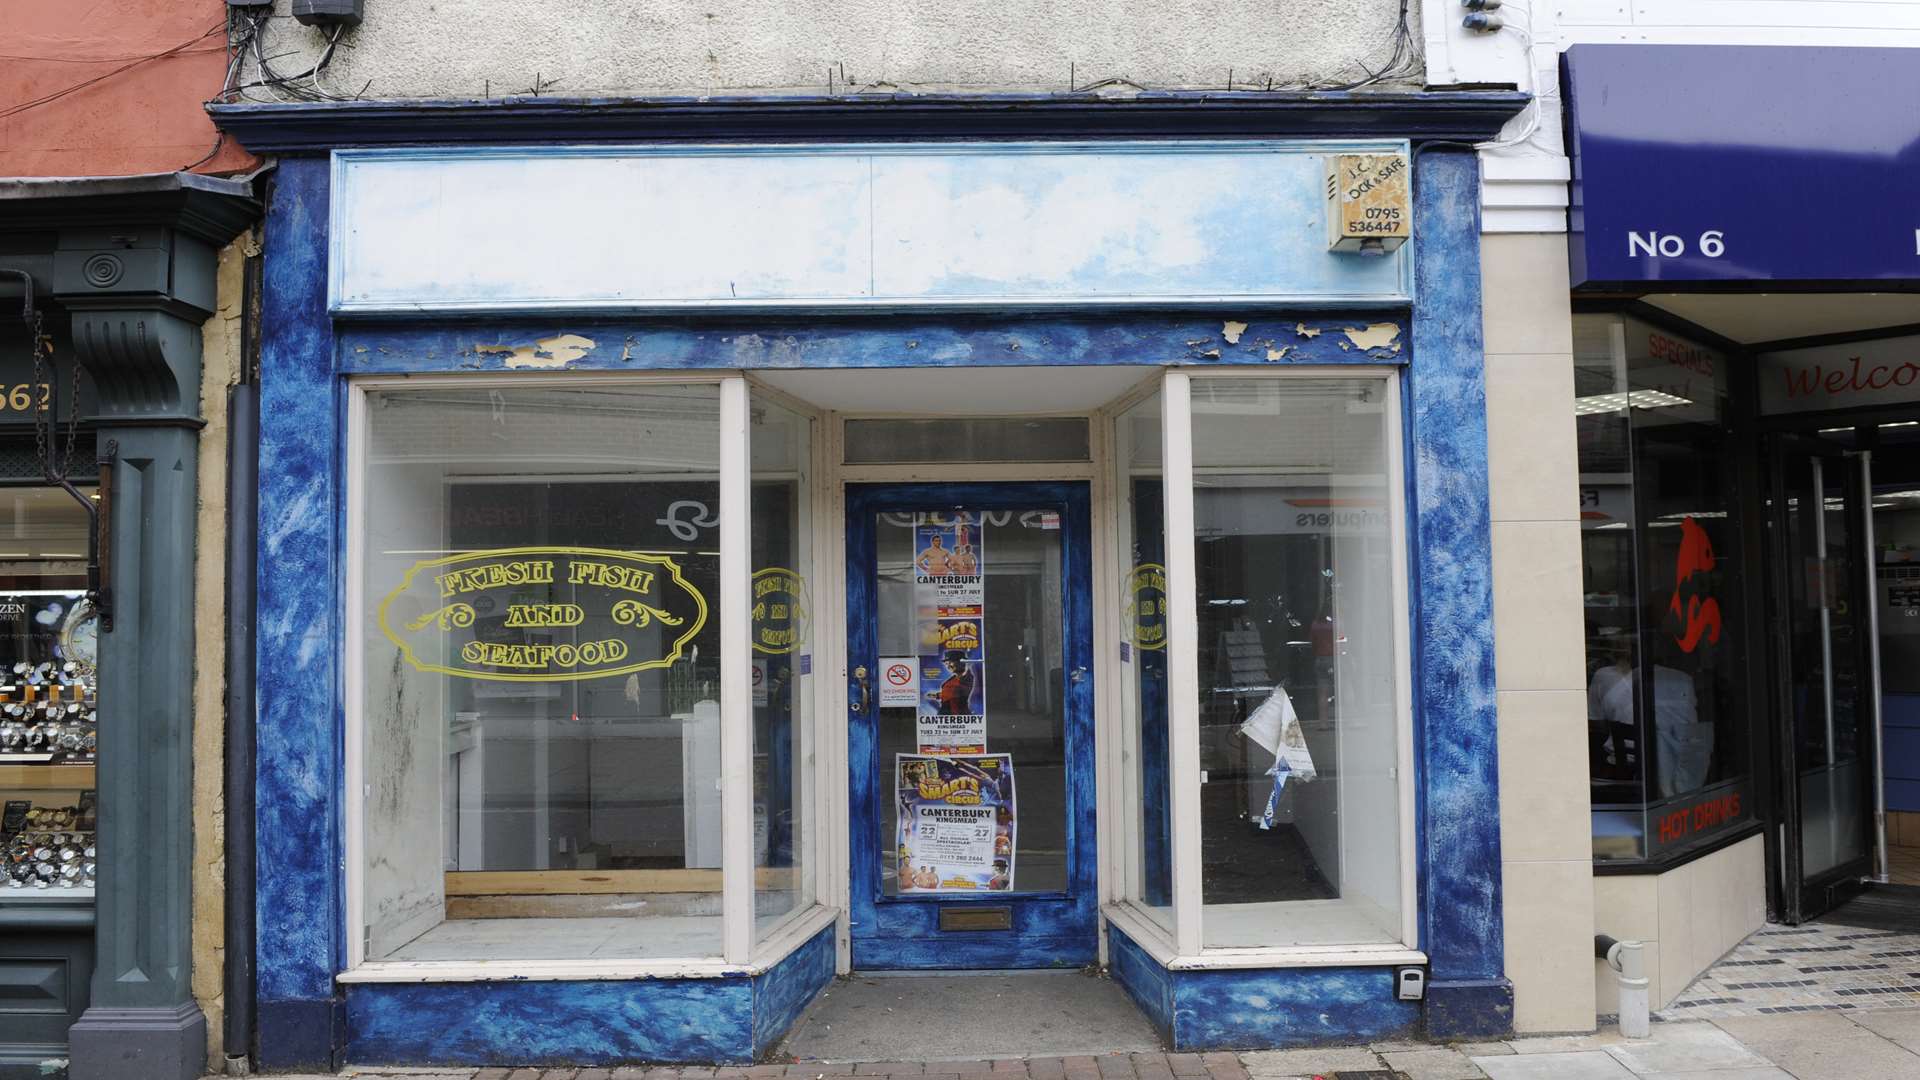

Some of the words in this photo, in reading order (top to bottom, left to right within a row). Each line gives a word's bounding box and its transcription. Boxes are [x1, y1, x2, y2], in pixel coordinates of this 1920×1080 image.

[1349, 179, 1375, 199] OCK
[1378, 158, 1406, 180] SAFE
[1365, 207, 1400, 219] 0795
[1349, 221, 1400, 233] 536447
[1628, 231, 1685, 257] No
[1699, 230, 1725, 257] 6
[1649, 332, 1713, 378] SPECIALS
[434, 560, 554, 598] FRESH
[567, 561, 655, 596] FISH
[917, 575, 981, 584] CANTERBURY
[0, 604, 25, 613] ZEN
[504, 603, 585, 628] AND
[944, 640, 979, 649] CIRCUS
[461, 639, 629, 668] SEAFOOD
[919, 715, 983, 725] CANTERBURY
[919, 776, 979, 800] SMART'S
[944, 795, 981, 804] CIRCUS
[920, 808, 991, 818] CANTERBURY
[1657, 811, 1692, 845] HOT
[1693, 793, 1742, 833] DRINKS
[975, 829, 989, 837] 27
